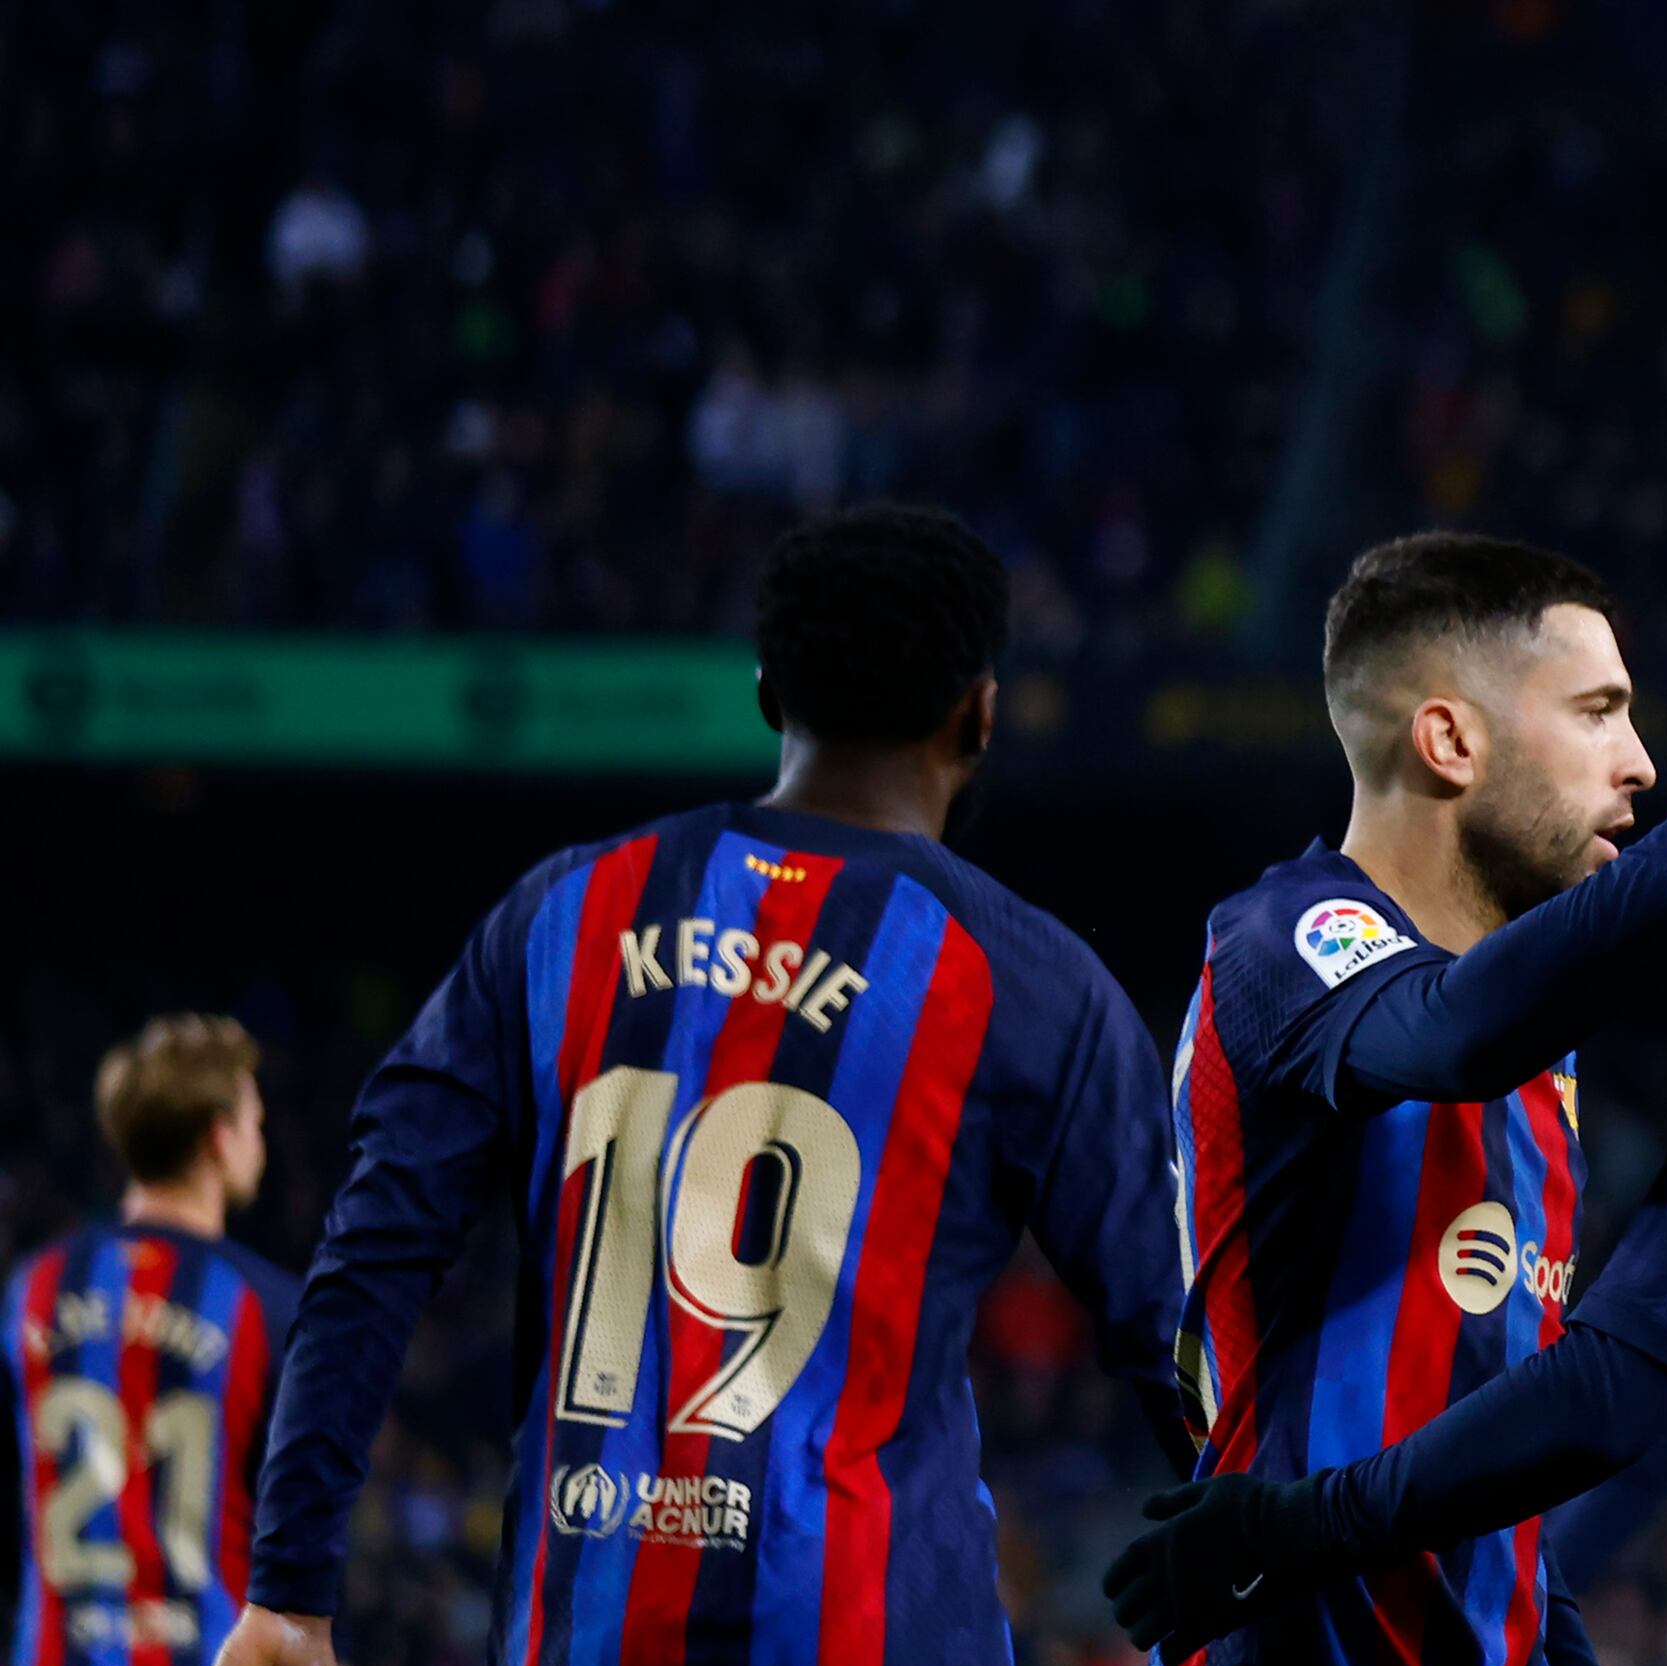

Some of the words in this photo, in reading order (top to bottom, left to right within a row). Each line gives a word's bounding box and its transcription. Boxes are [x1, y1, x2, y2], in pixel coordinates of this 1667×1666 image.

[618, 916, 870, 1035] KESSIE
[553, 1063, 862, 1443] 19
[34, 1375, 217, 1595] 21
[629, 1502, 750, 1540] ACNUR
[636, 1471, 752, 1513] UNHCR
